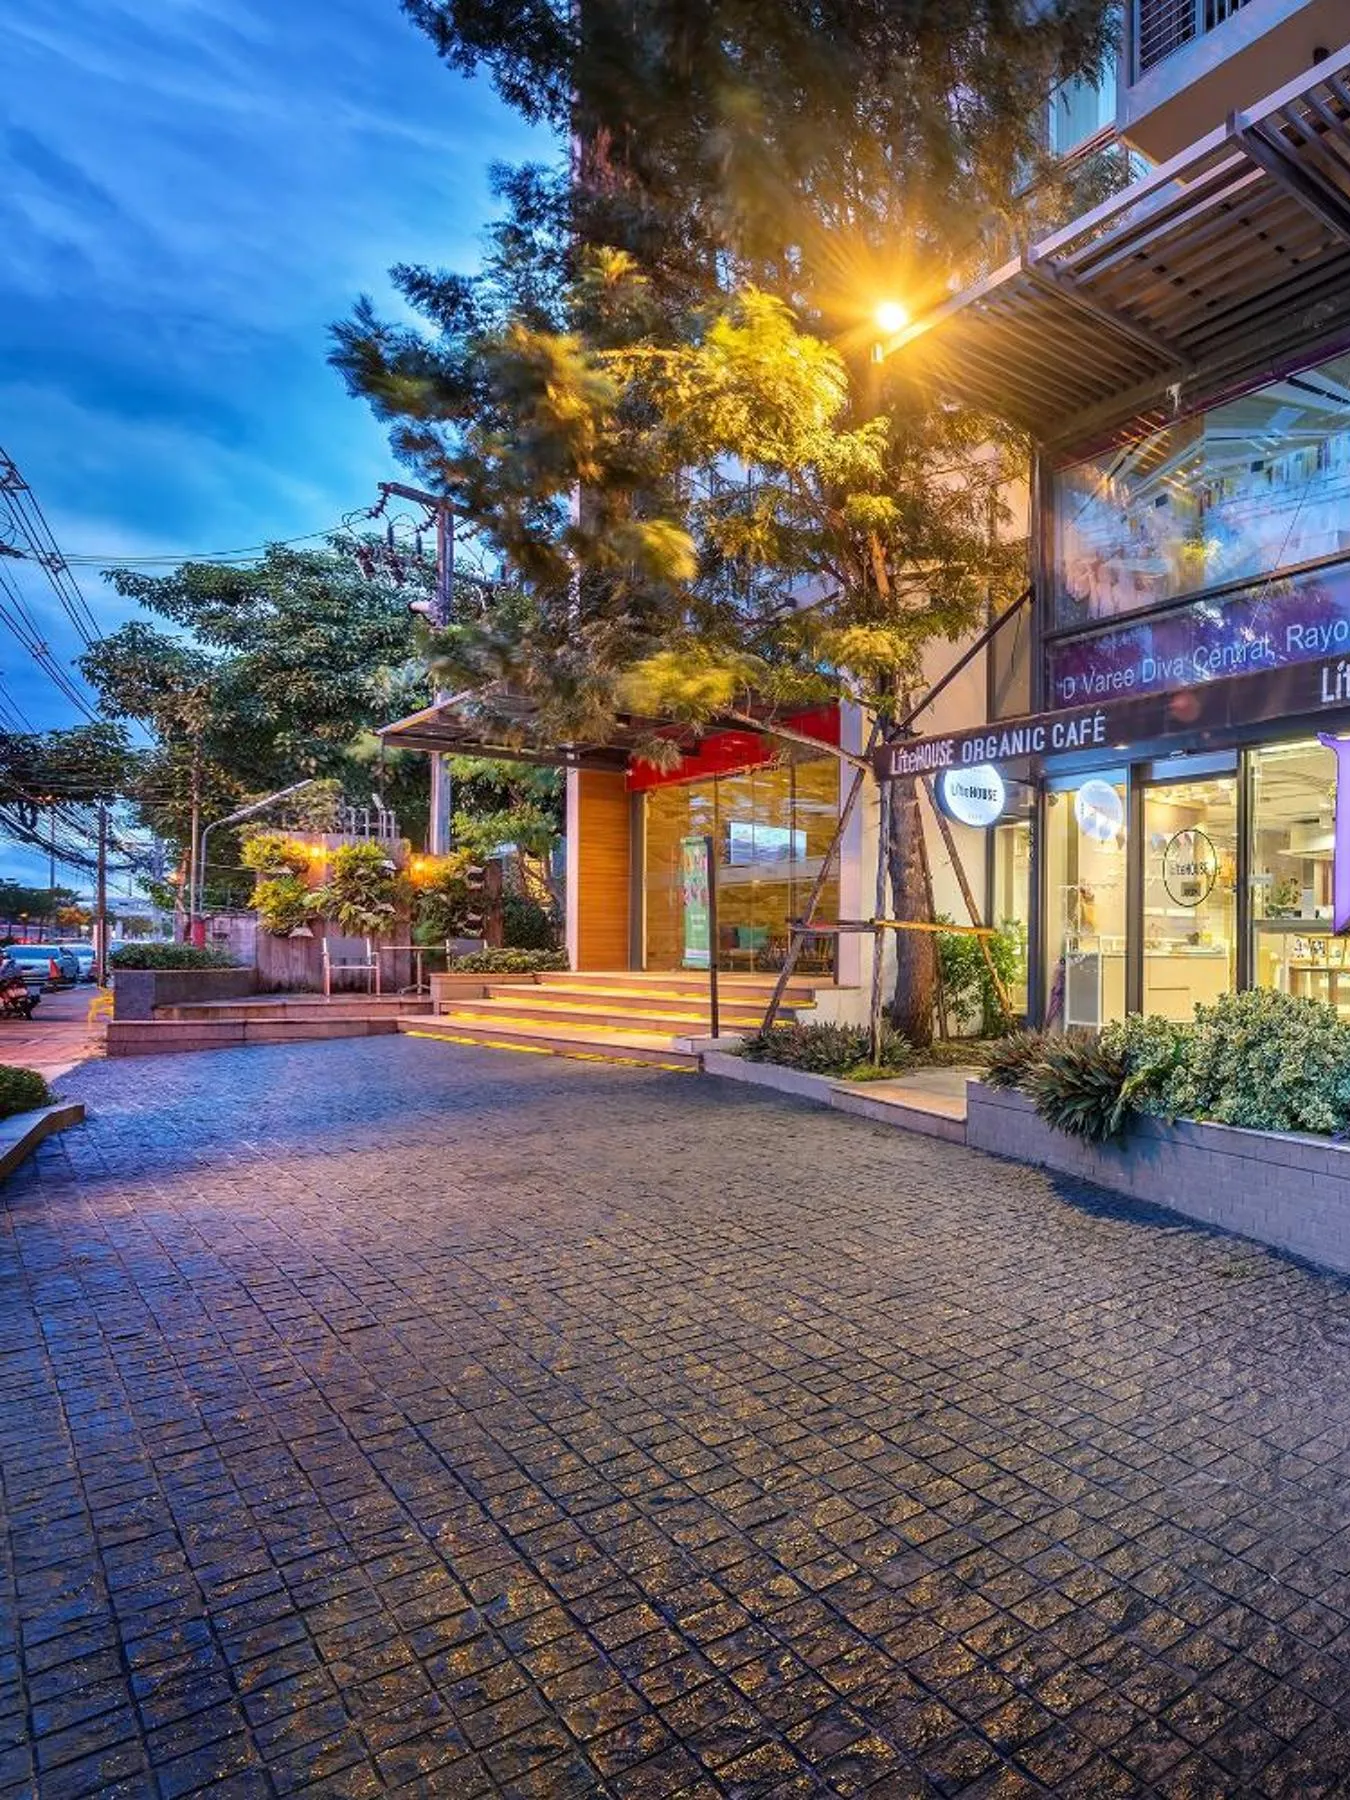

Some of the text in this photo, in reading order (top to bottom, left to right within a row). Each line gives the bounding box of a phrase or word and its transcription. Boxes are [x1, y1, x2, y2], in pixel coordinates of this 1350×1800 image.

[1063, 676, 1076, 699] D
[1083, 664, 1134, 694] Varee
[1142, 656, 1185, 683] Diva
[962, 726, 1046, 764] ORGANIC
[1052, 710, 1106, 749] CAFÉ
